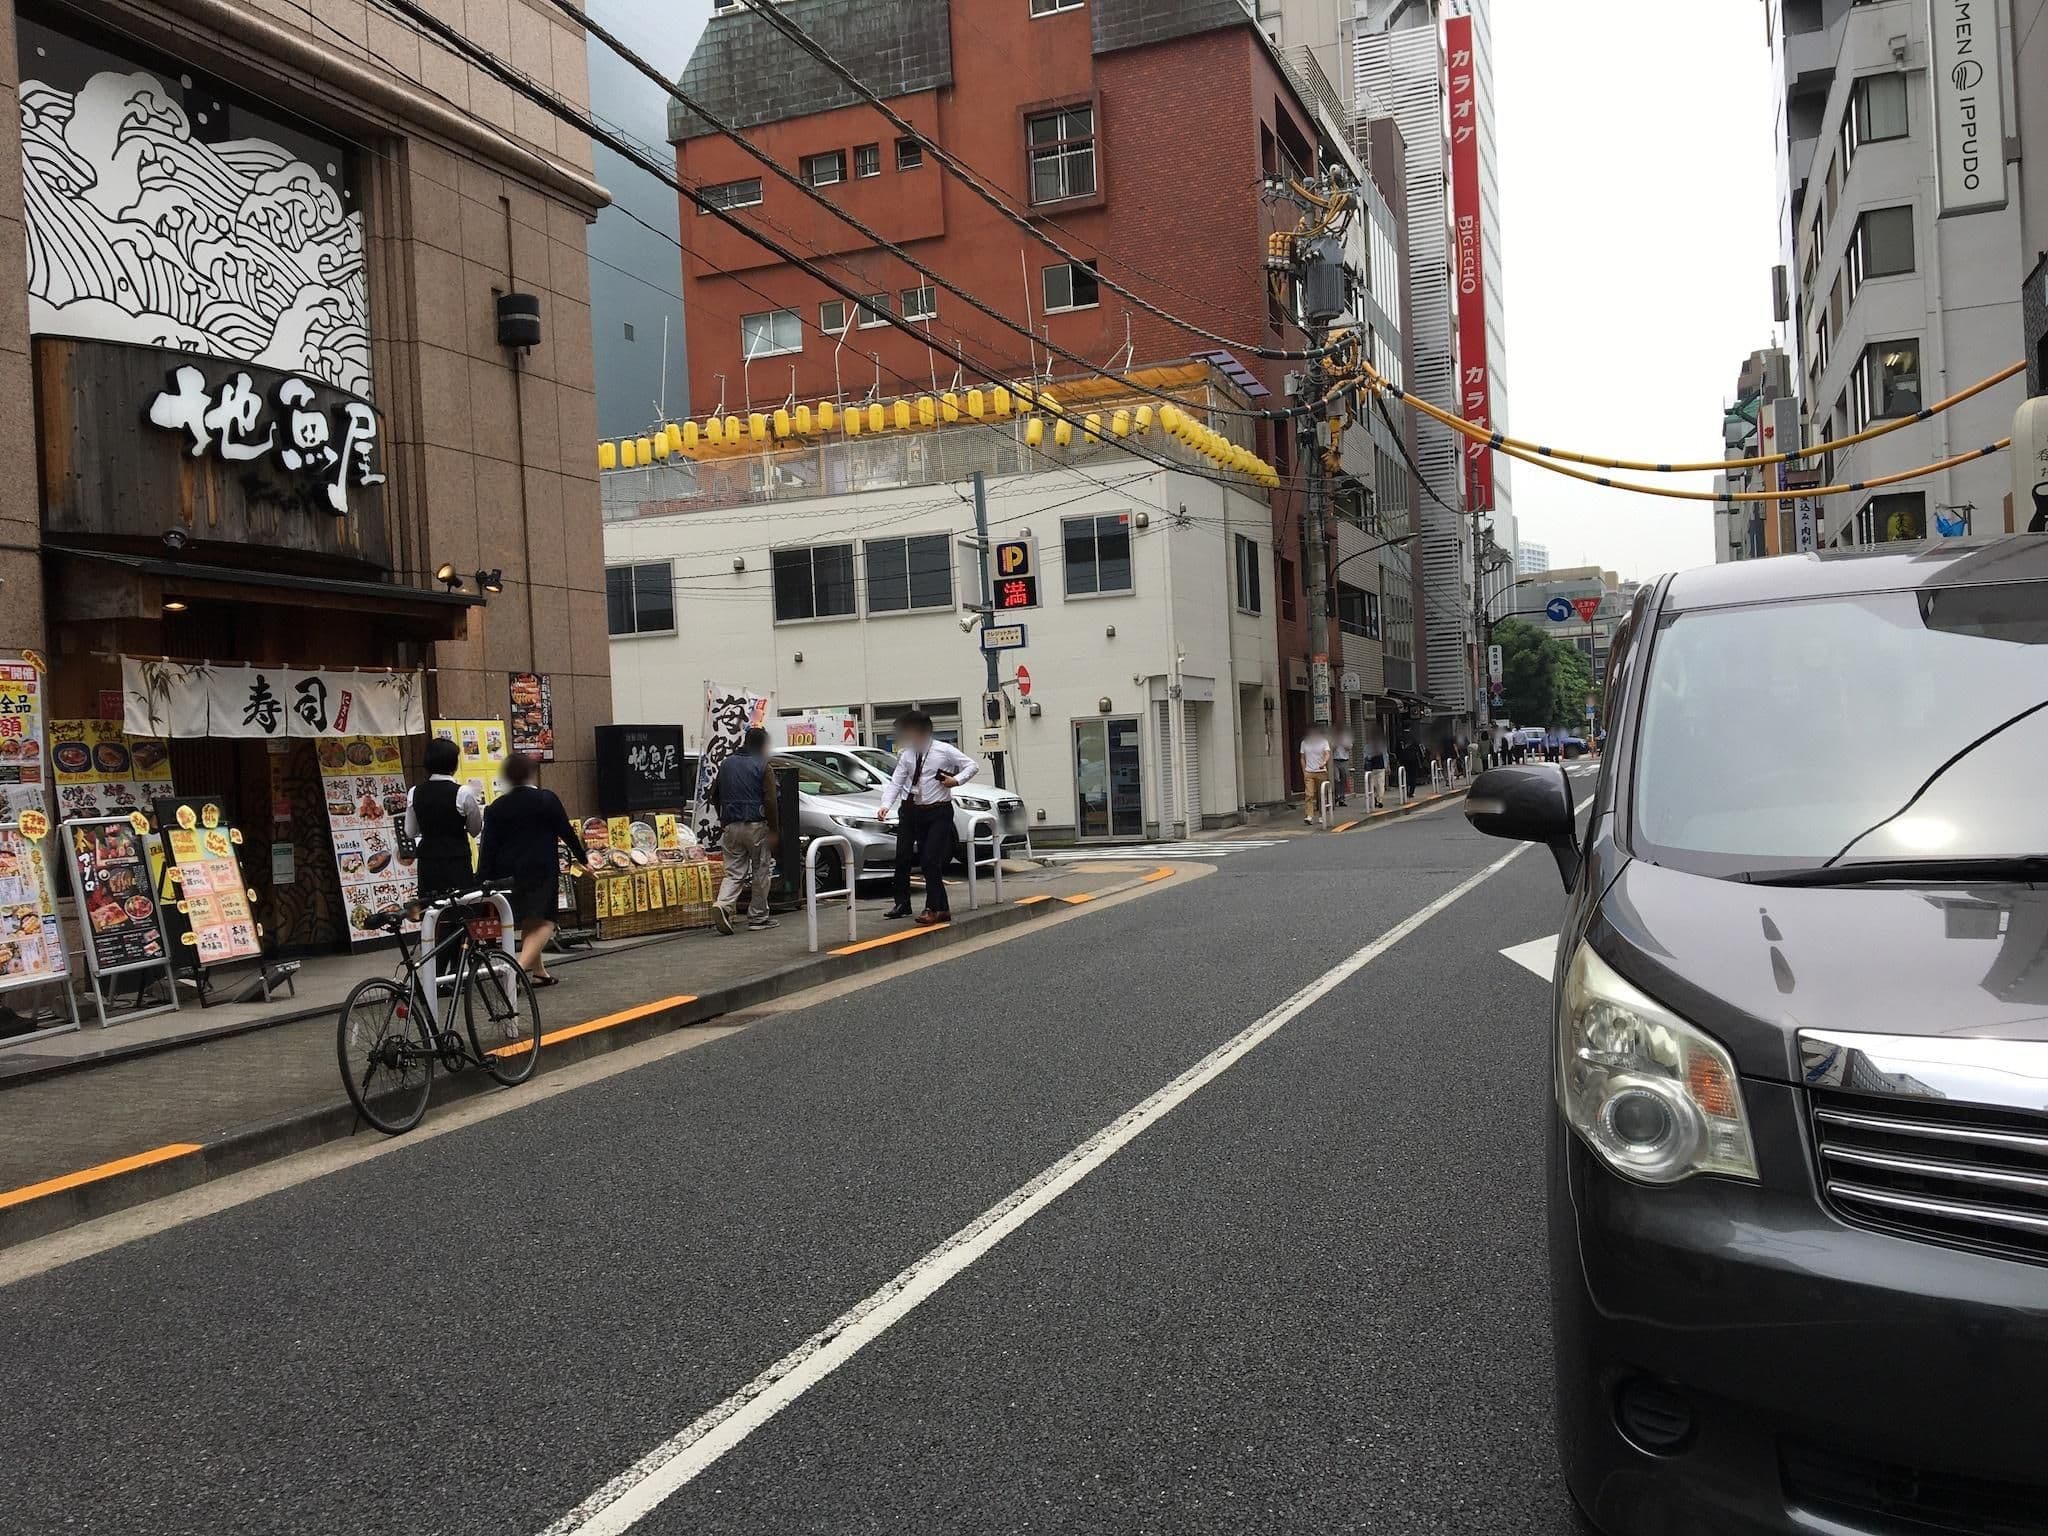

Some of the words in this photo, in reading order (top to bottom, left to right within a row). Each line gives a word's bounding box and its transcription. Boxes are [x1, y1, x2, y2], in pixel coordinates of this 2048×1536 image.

[1954, 0, 1972, 55] MEN
[1451, 49, 1475, 145] カラオケ
[1959, 96, 1980, 190] IPPUDO
[150, 365, 386, 514] 地魚屋
[1003, 546, 1024, 573] P
[1004, 580, 1027, 607] 満
[0, 693, 32, 714] 全品
[242, 674, 328, 734] 寿司
[628, 745, 679, 780] 地魚屋
